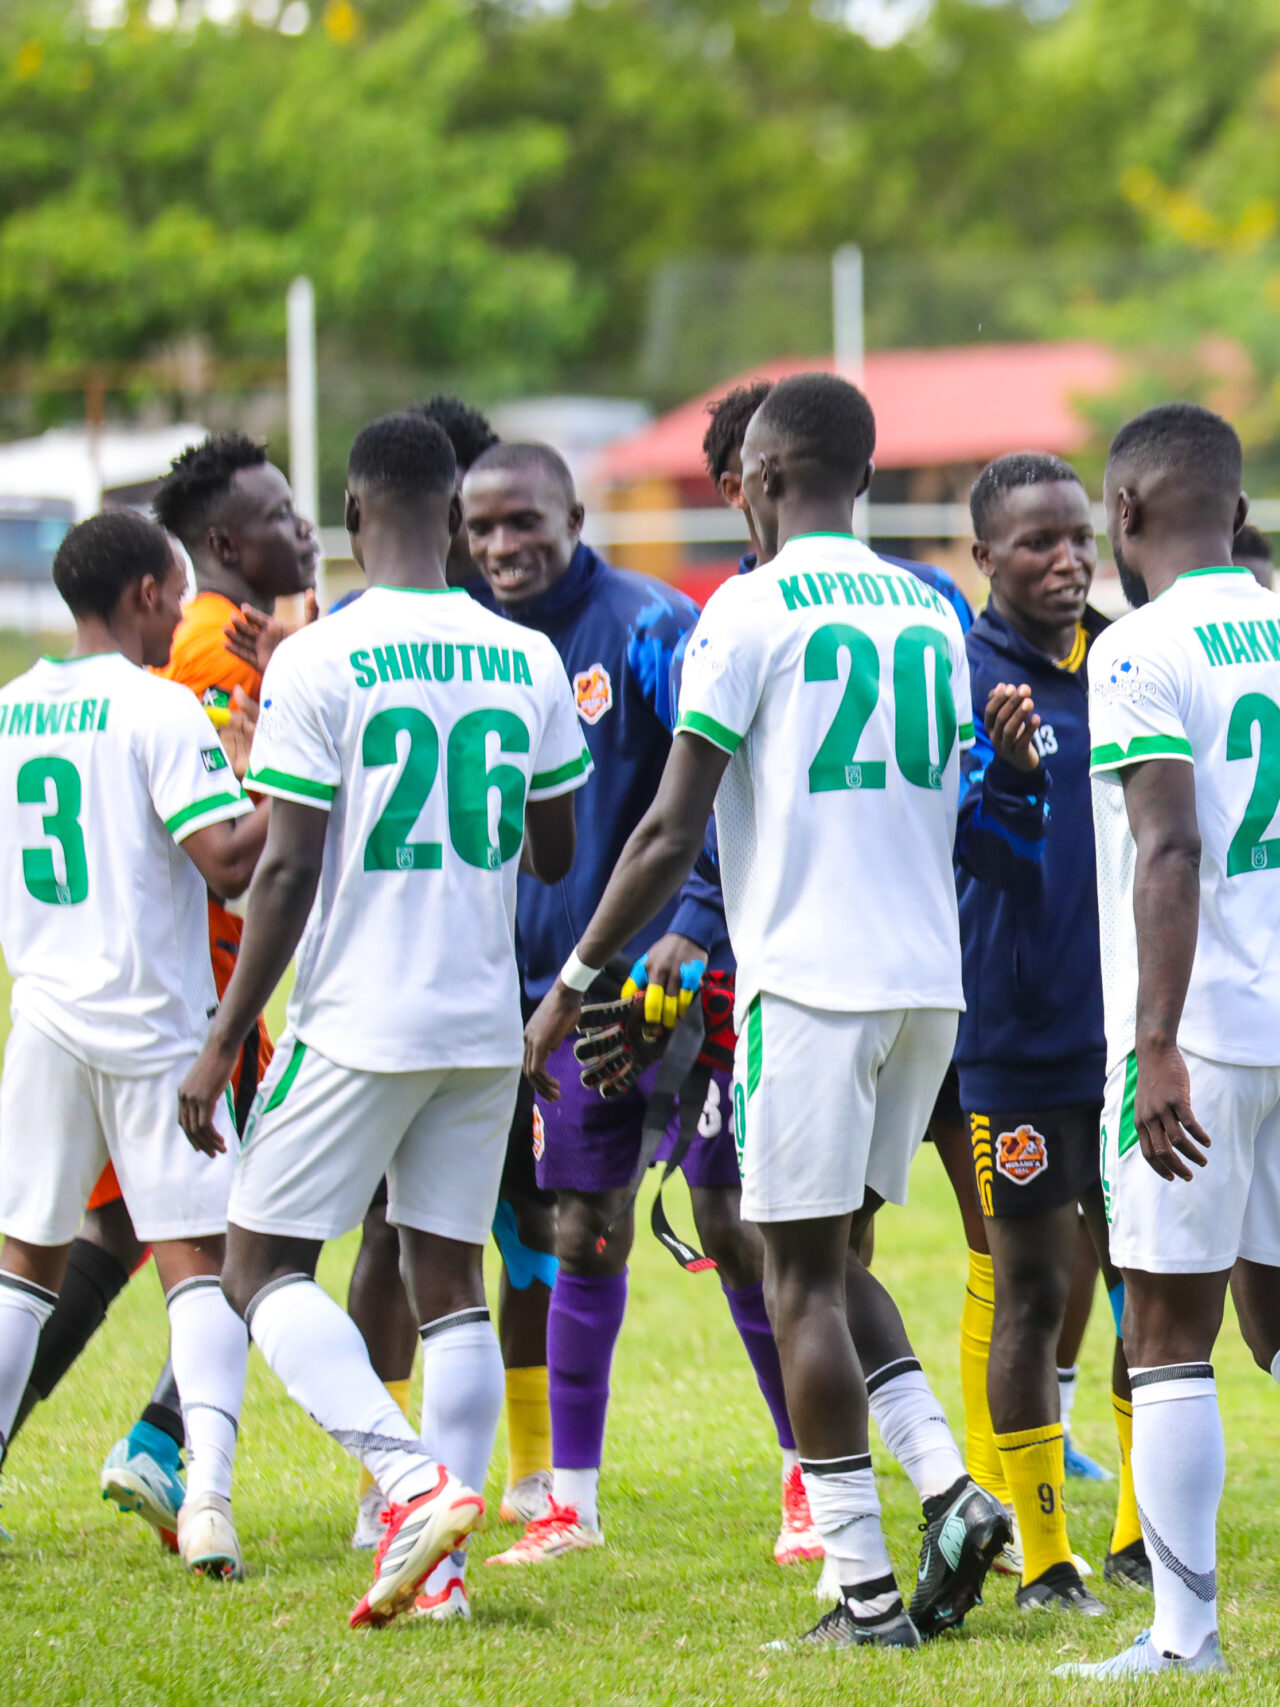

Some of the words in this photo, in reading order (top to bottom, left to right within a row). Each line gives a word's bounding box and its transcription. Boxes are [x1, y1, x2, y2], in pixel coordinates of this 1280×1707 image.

[350, 641, 534, 688] SHIKUTWA
[804, 622, 957, 794] 20
[17, 756, 89, 906] 3
[362, 706, 530, 872] 26
